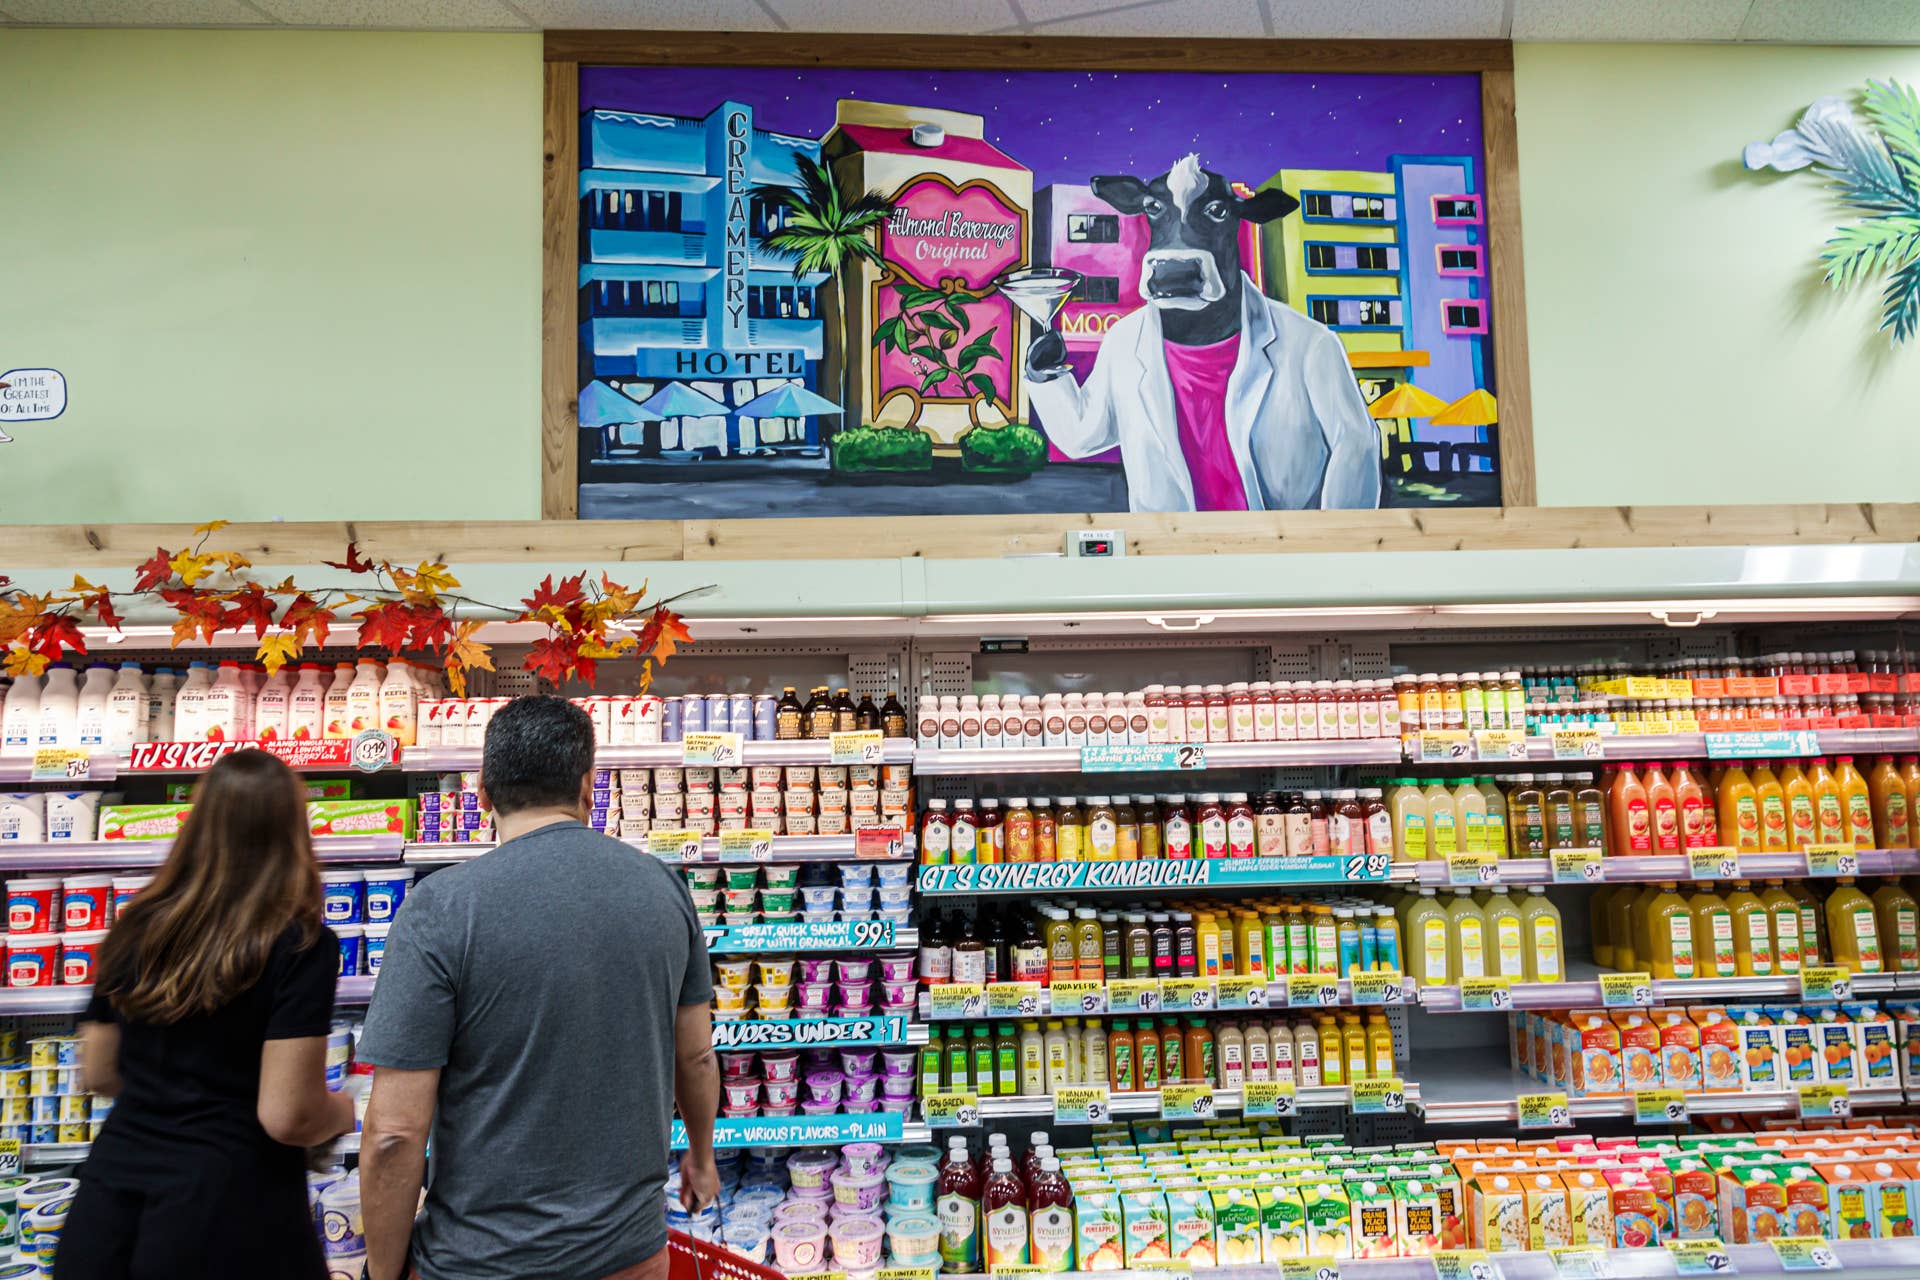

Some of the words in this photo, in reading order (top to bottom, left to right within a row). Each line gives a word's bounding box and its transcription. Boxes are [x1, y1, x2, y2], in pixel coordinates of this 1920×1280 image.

[727, 111, 747, 329] CREAMERY
[888, 206, 948, 237] Almond
[950, 209, 1015, 248] Beverage
[915, 239, 989, 267] Original
[676, 351, 803, 375] HOTEL
[3, 388, 49, 400] GREATEST
[132, 743, 183, 769] TJ'S
[922, 864, 975, 890] GT'S
[977, 862, 1085, 890] SYNERGY
[1084, 859, 1210, 888] KOMBUCHA
[809, 923, 850, 936] SNACK!
[766, 936, 798, 948] WITH
[1053, 983, 1073, 991] AQUA
[711, 1022, 793, 1046] AVORS
[794, 1020, 873, 1043] UNDER
[744, 1125, 789, 1142] VARIOUS
[789, 1124, 839, 1140] FLAVORS
[1362, 1211, 1387, 1219] ORANGE
[1407, 1210, 1432, 1218] ORANGE
[1085, 1225, 1116, 1233] PINEAPPLE
[1132, 1224, 1163, 1232] PINEAPPLE
[1178, 1223, 1208, 1231] PINEAPPLE
